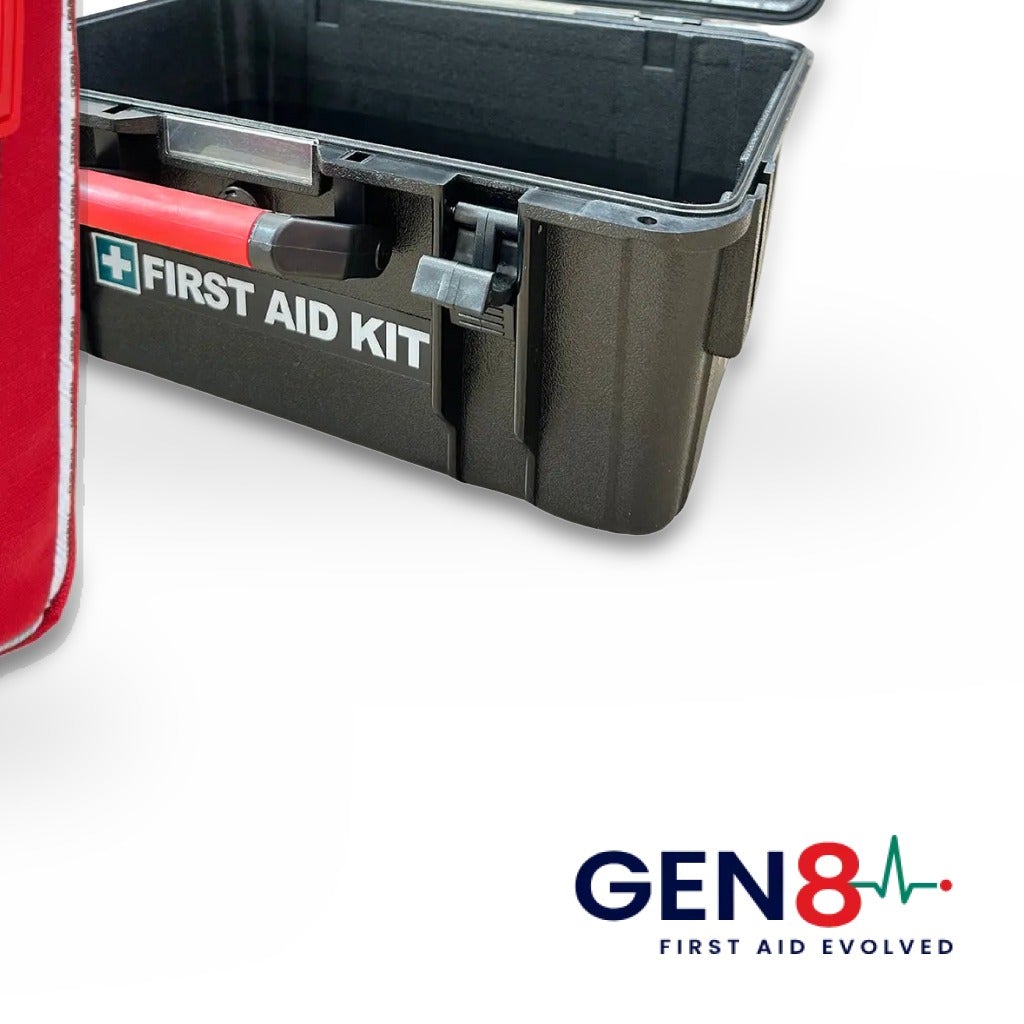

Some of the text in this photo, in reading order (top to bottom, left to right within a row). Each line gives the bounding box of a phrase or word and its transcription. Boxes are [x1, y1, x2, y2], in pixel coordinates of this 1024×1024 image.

[141, 253, 255, 317] FIRST
[264, 289, 340, 342] AID
[350, 311, 431, 369] KIT
